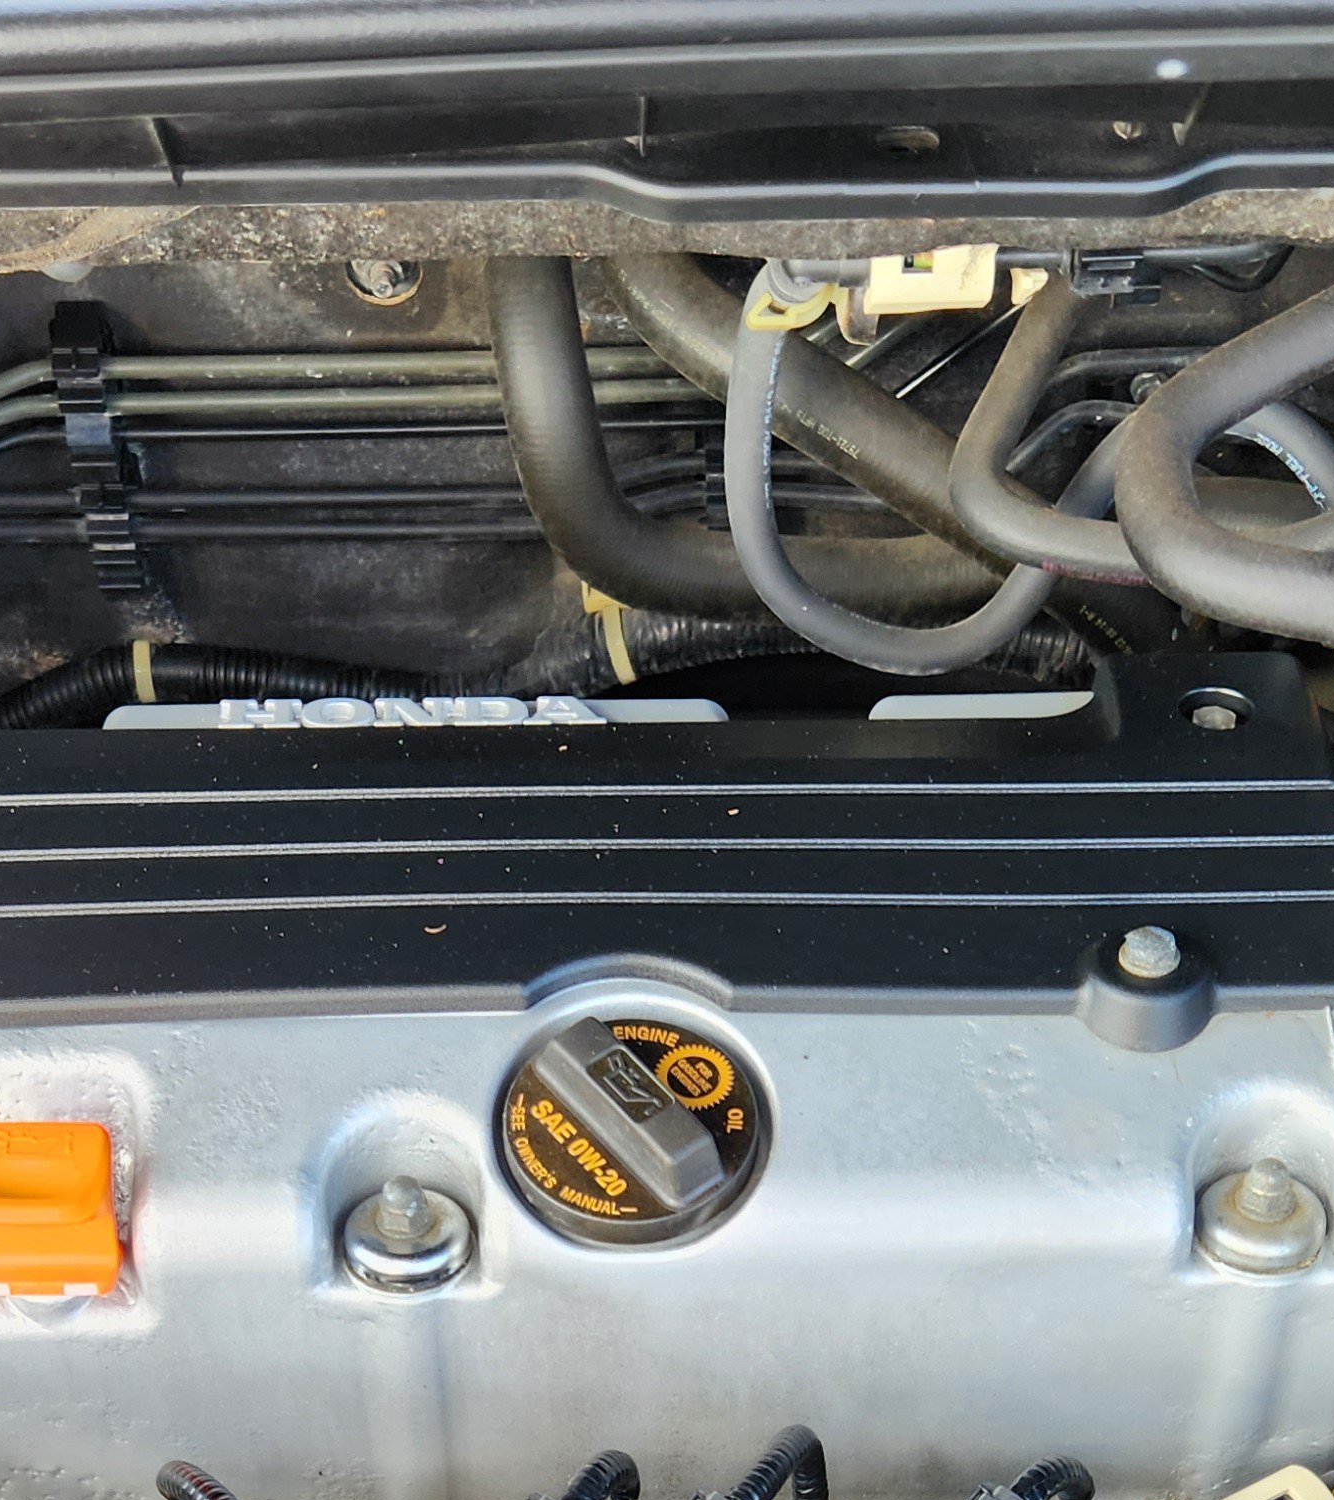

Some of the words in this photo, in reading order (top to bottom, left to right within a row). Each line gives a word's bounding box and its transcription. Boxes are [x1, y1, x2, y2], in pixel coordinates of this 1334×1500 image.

[218, 695, 607, 728] HONDA
[612, 1025, 679, 1048] ENGINE
[694, 1061, 713, 1080] FOR
[726, 1108, 744, 1135] OIL
[530, 1099, 578, 1145] SAE
[567, 1137, 628, 1198] 0W-20
[513, 1136, 558, 1190] OWNER'S
[558, 1184, 621, 1216] MANUAL
